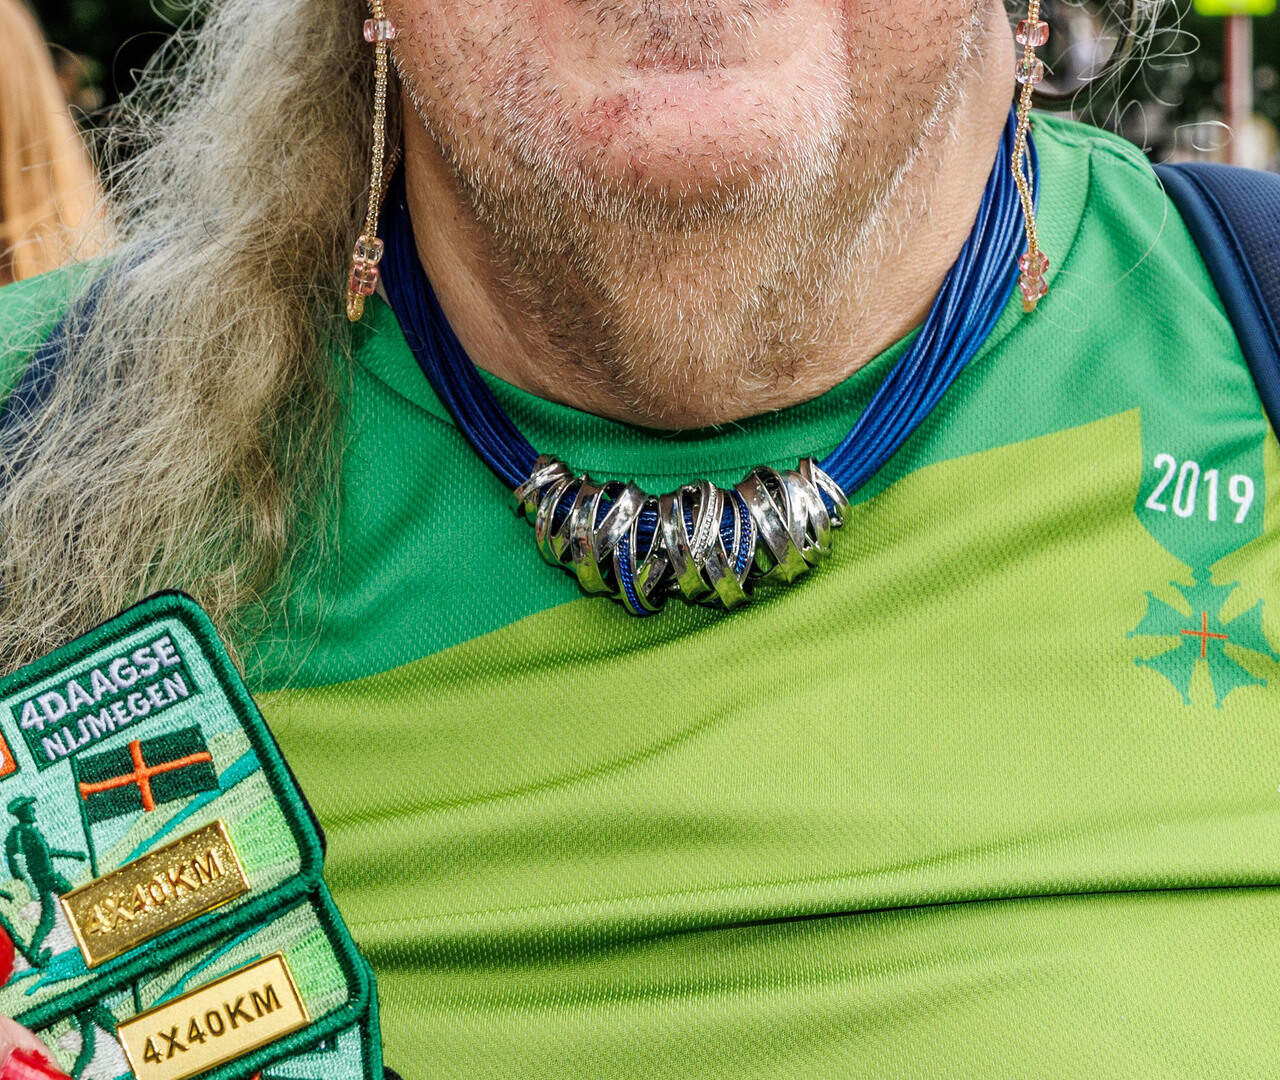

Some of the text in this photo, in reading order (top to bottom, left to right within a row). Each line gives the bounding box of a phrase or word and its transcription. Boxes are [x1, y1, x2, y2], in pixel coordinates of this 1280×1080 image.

[1145, 453, 1255, 524] 2019
[20, 635, 181, 731] 4DAAGSE
[41, 672, 190, 761] NIJMEGEN
[86, 847, 226, 936] 4X40KM
[142, 984, 283, 1065] 4X40KM
